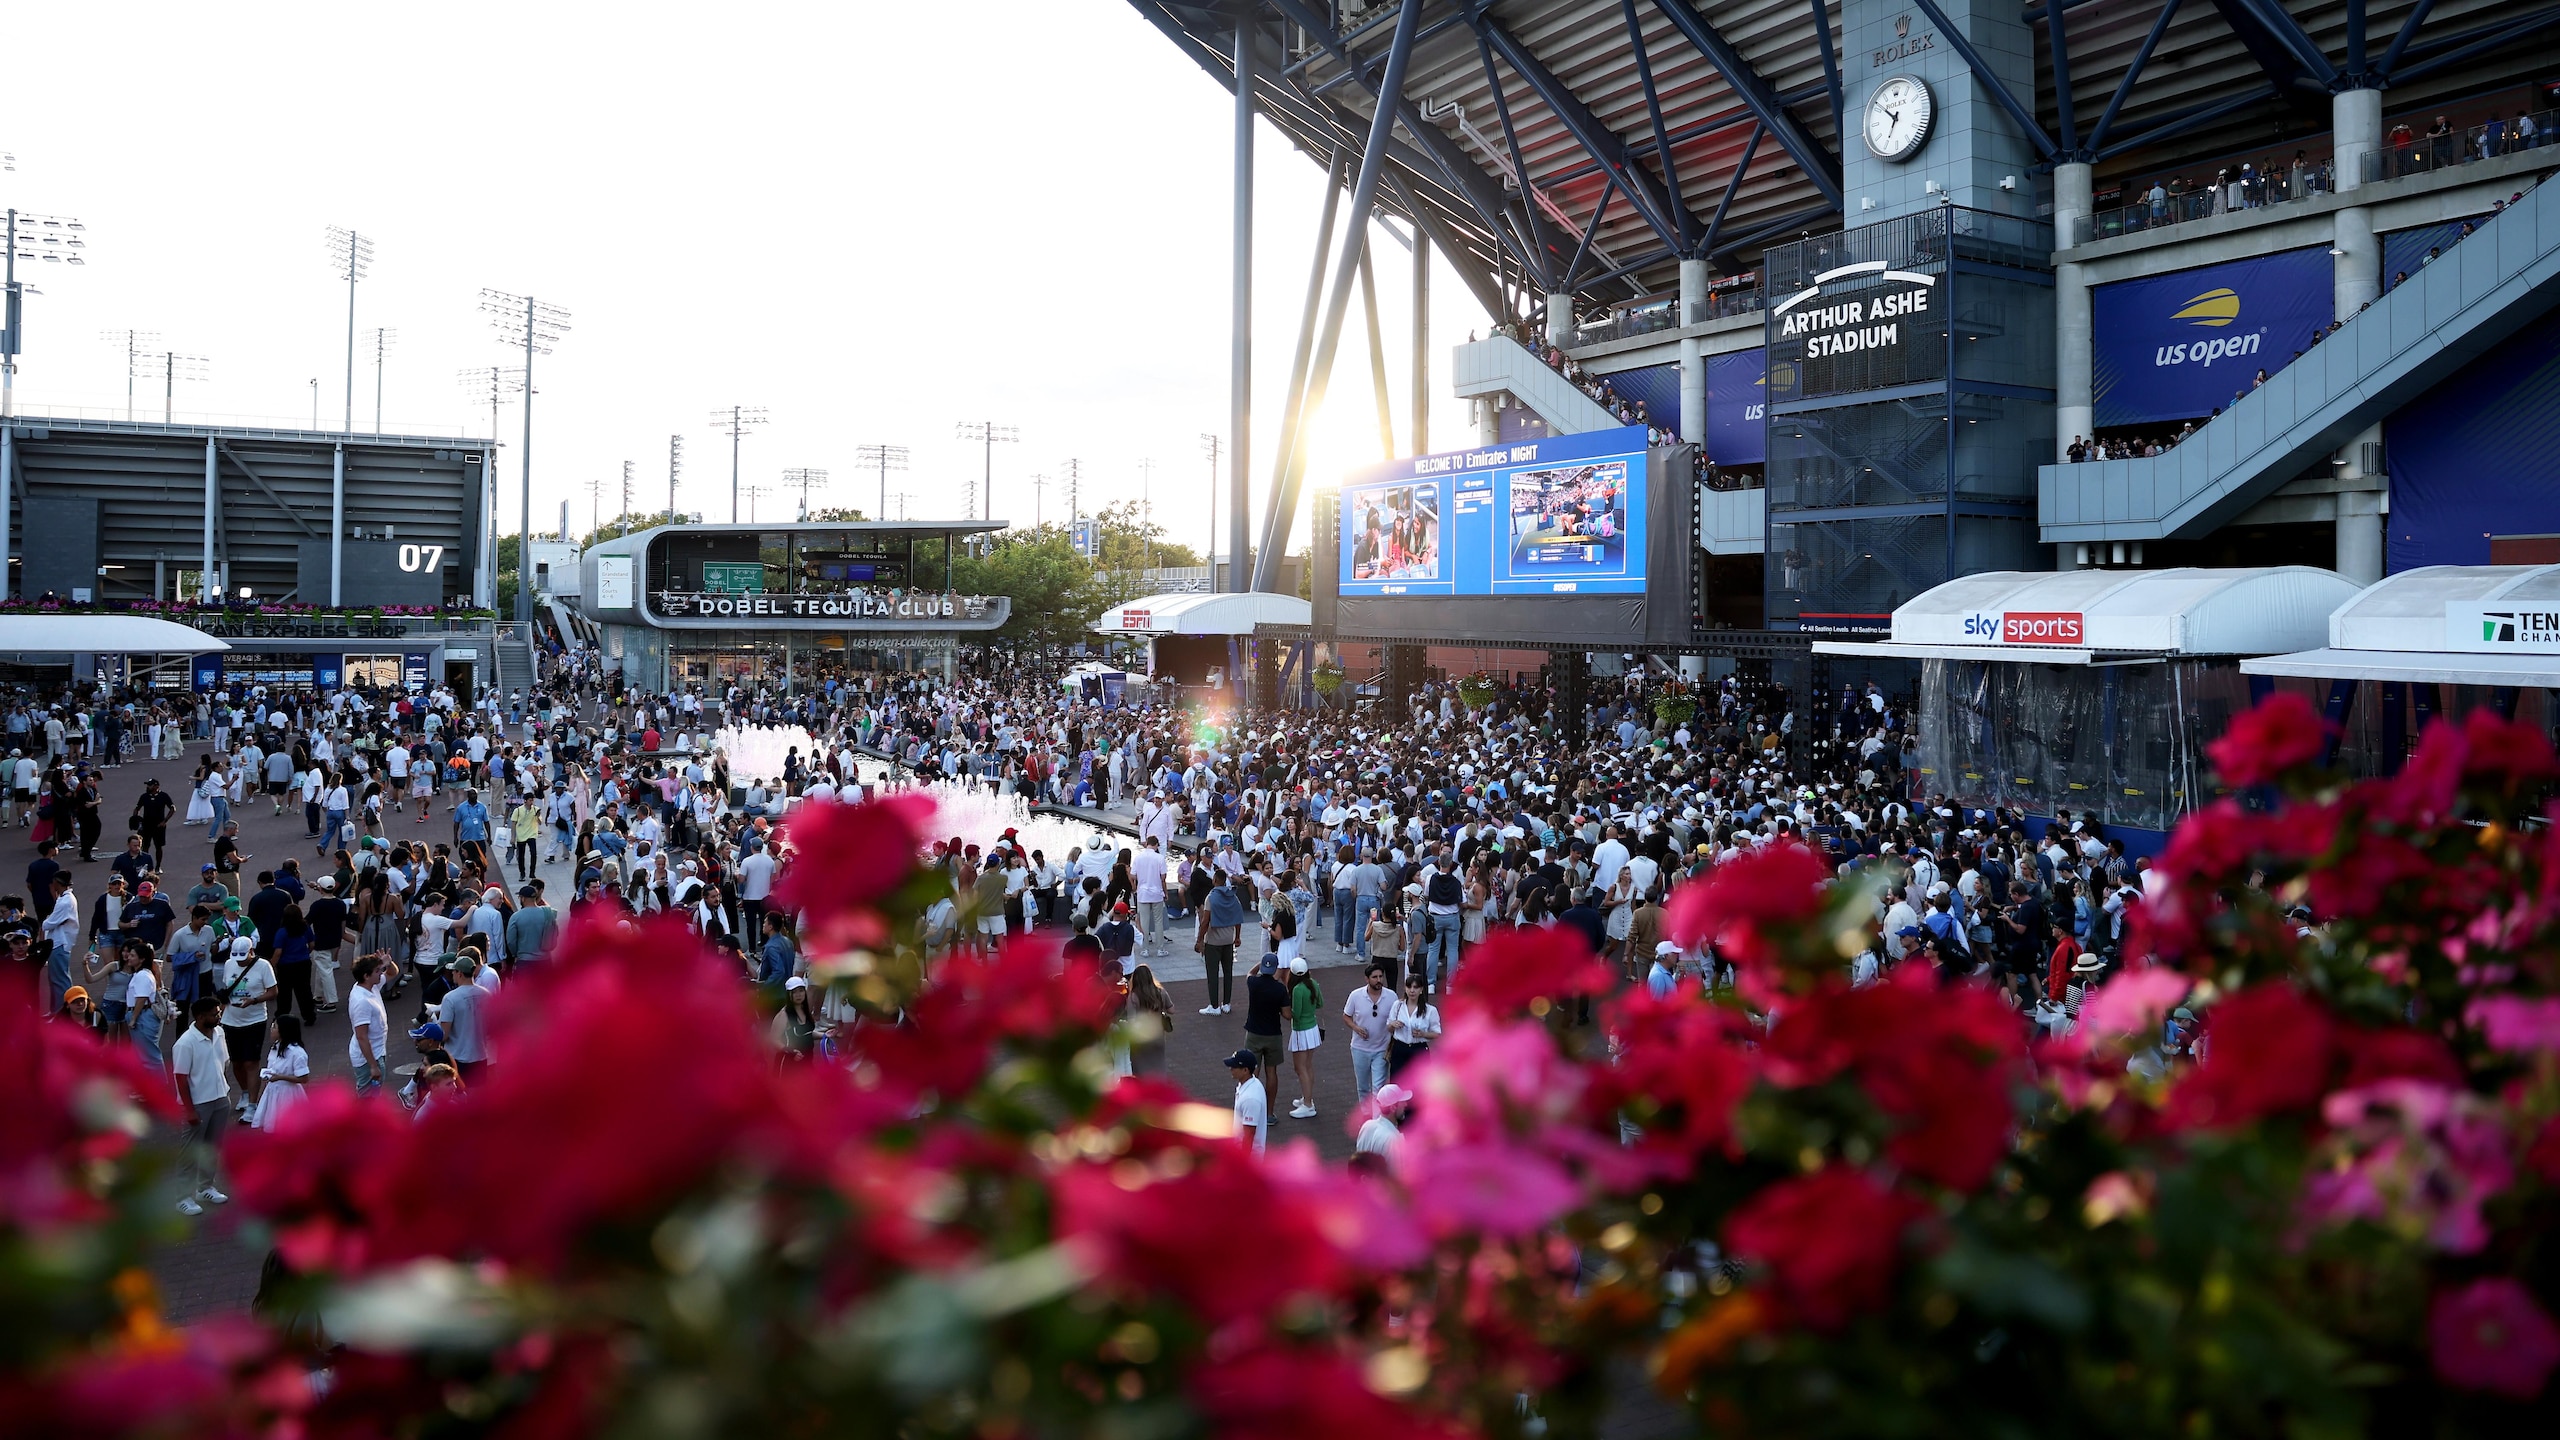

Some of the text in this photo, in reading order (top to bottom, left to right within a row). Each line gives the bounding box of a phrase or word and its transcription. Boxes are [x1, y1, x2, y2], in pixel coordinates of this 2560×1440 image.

[1872, 33, 1934, 68] ROLEX
[1886, 99, 1907, 110] ROLEX
[1782, 289, 1928, 336] ARTHUR ASHE
[1807, 323, 1897, 358] STADIUM
[2155, 333, 2261, 367] us open
[1744, 404, 1765, 420] us
[1414, 444, 1538, 474] WELCOME TO Emirates NIGHT
[399, 544, 443, 573] 07
[700, 599, 954, 616] DOBEL TEQUILA CLUB
[1123, 610, 1151, 628] ESPN
[1964, 613, 2079, 640] sky sports
[2519, 613, 2559, 631] TEN
[253, 624, 349, 637] EXPRESS
[357, 625, 407, 637] SHOP
[853, 635, 956, 650] us open collection
